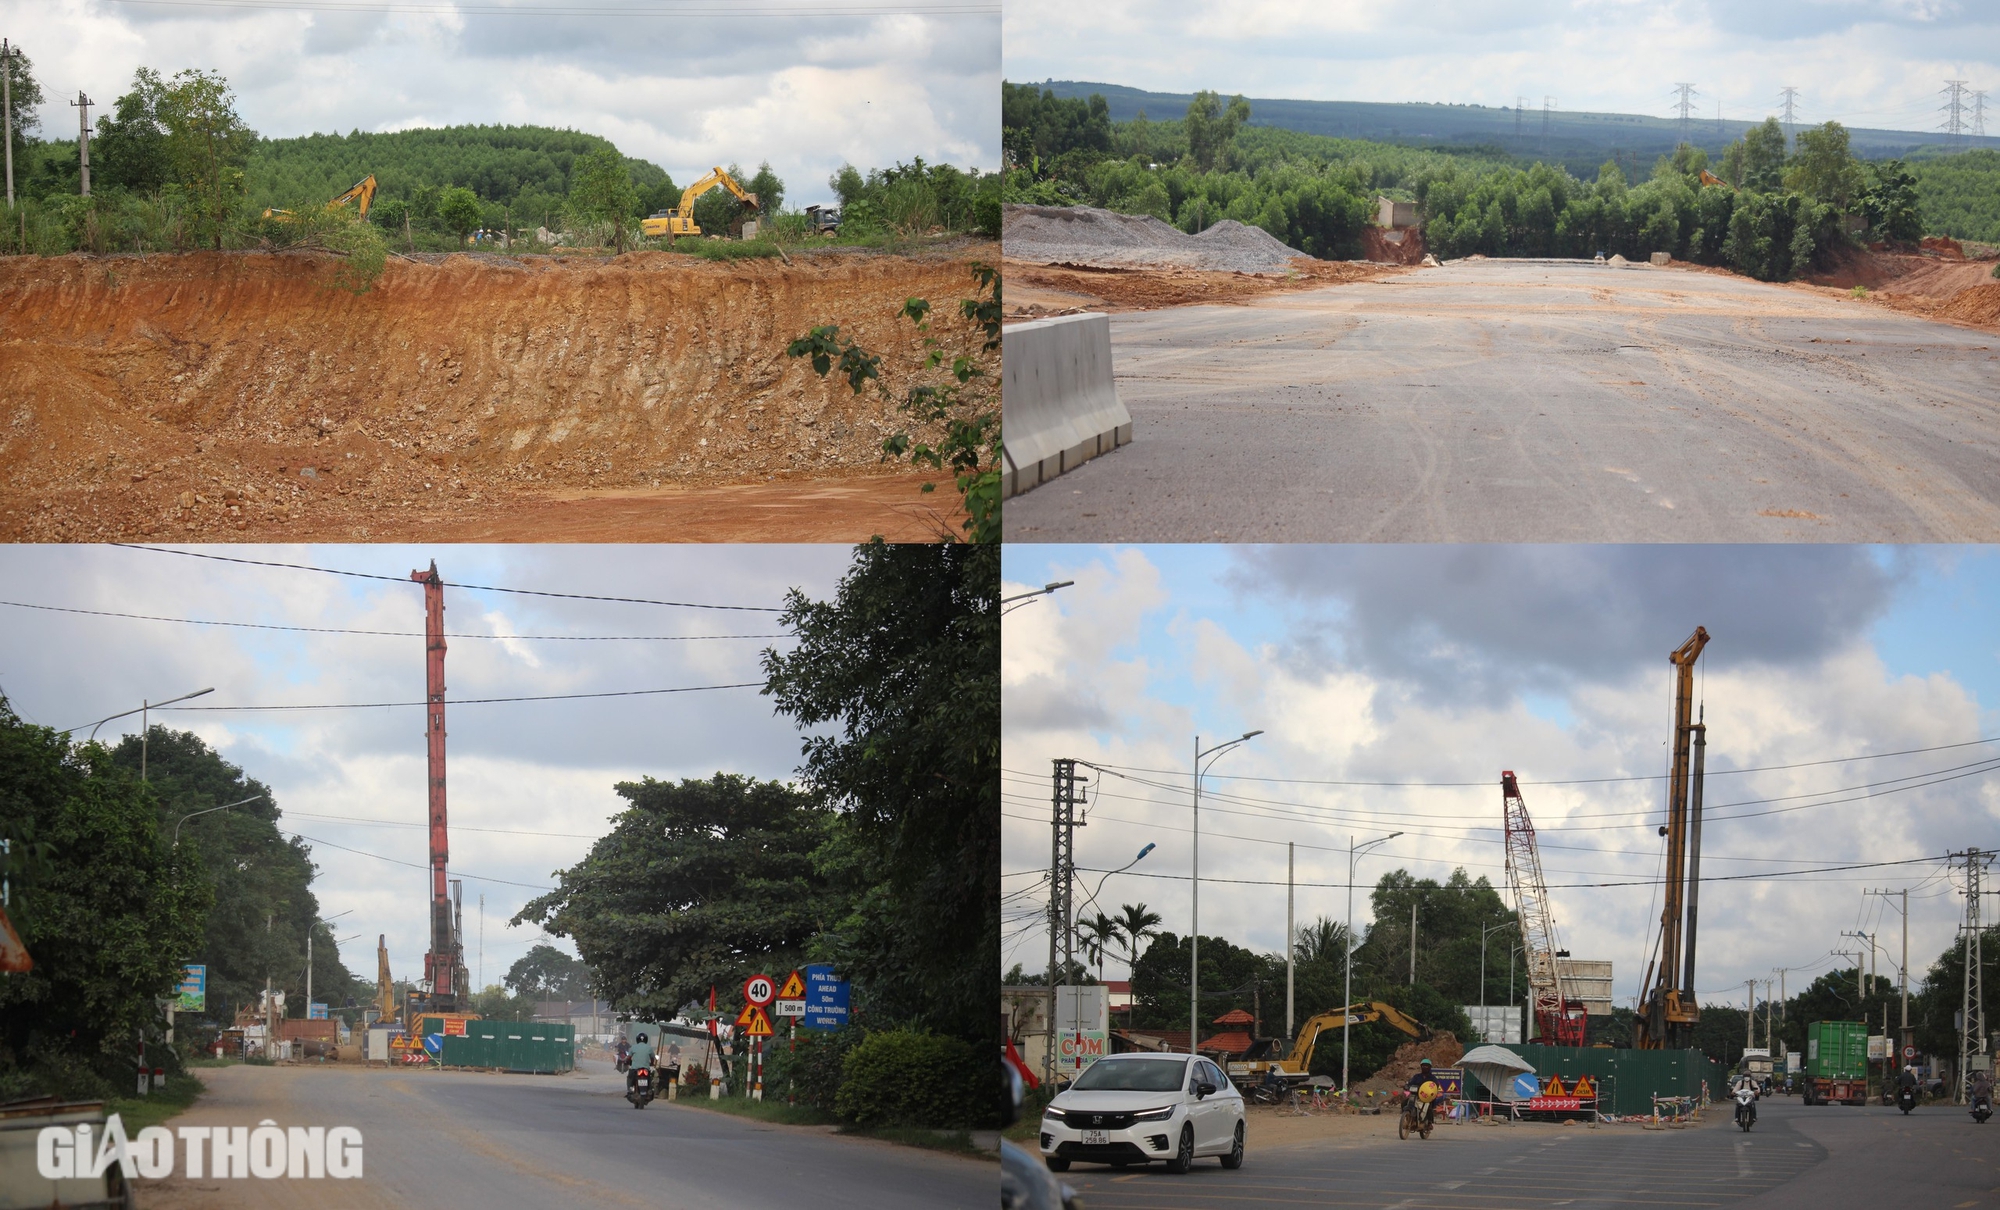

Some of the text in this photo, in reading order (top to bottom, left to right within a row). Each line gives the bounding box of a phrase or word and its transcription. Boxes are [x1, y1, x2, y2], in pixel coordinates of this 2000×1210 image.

[811, 972, 826, 981] PHÍA
[751, 983, 768, 998] 40
[818, 985, 837, 993] AHEAD
[821, 995, 834, 1003] 50m
[784, 1004, 796, 1012] 500
[807, 1004, 823, 1013] CÔNG
[816, 1017, 837, 1025] WORKS
[1061, 1034, 1104, 1056] CƠM
